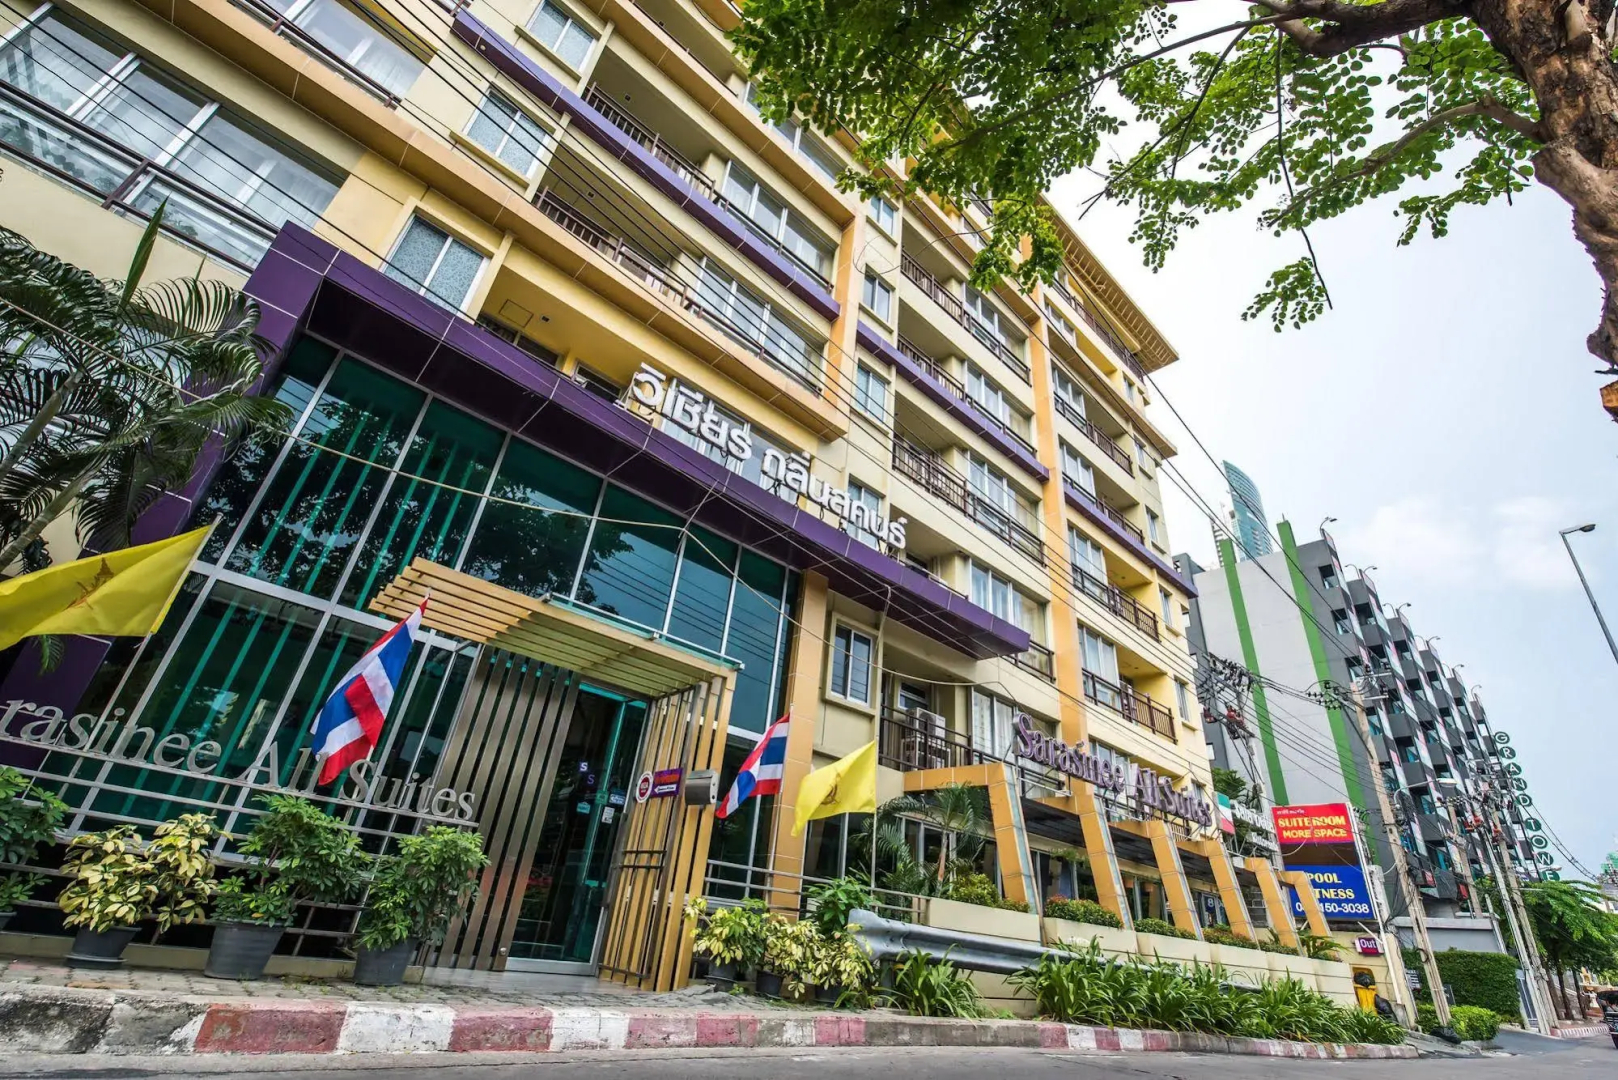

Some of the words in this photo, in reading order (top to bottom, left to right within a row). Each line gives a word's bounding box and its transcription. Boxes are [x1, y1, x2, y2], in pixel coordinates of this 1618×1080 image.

[0, 699, 222, 774] rasinee
[230, 741, 329, 796] All
[338, 758, 476, 821] Suites
[1013, 712, 1126, 794] Sarasinee
[1129, 762, 1162, 808] All
[1497, 733, 1531, 806] GRAND
[1527, 818, 1555, 881] TOWE
[1278, 817, 1311, 827] SUITE
[1312, 815, 1346, 826] ROOM
[1283, 829, 1312, 838] MORE
[1314, 828, 1347, 838] SPACE
[1313, 888, 1355, 899] TNESS
[1295, 902, 1369, 913] 0150-3038
[1360, 939, 1377, 949] Out
